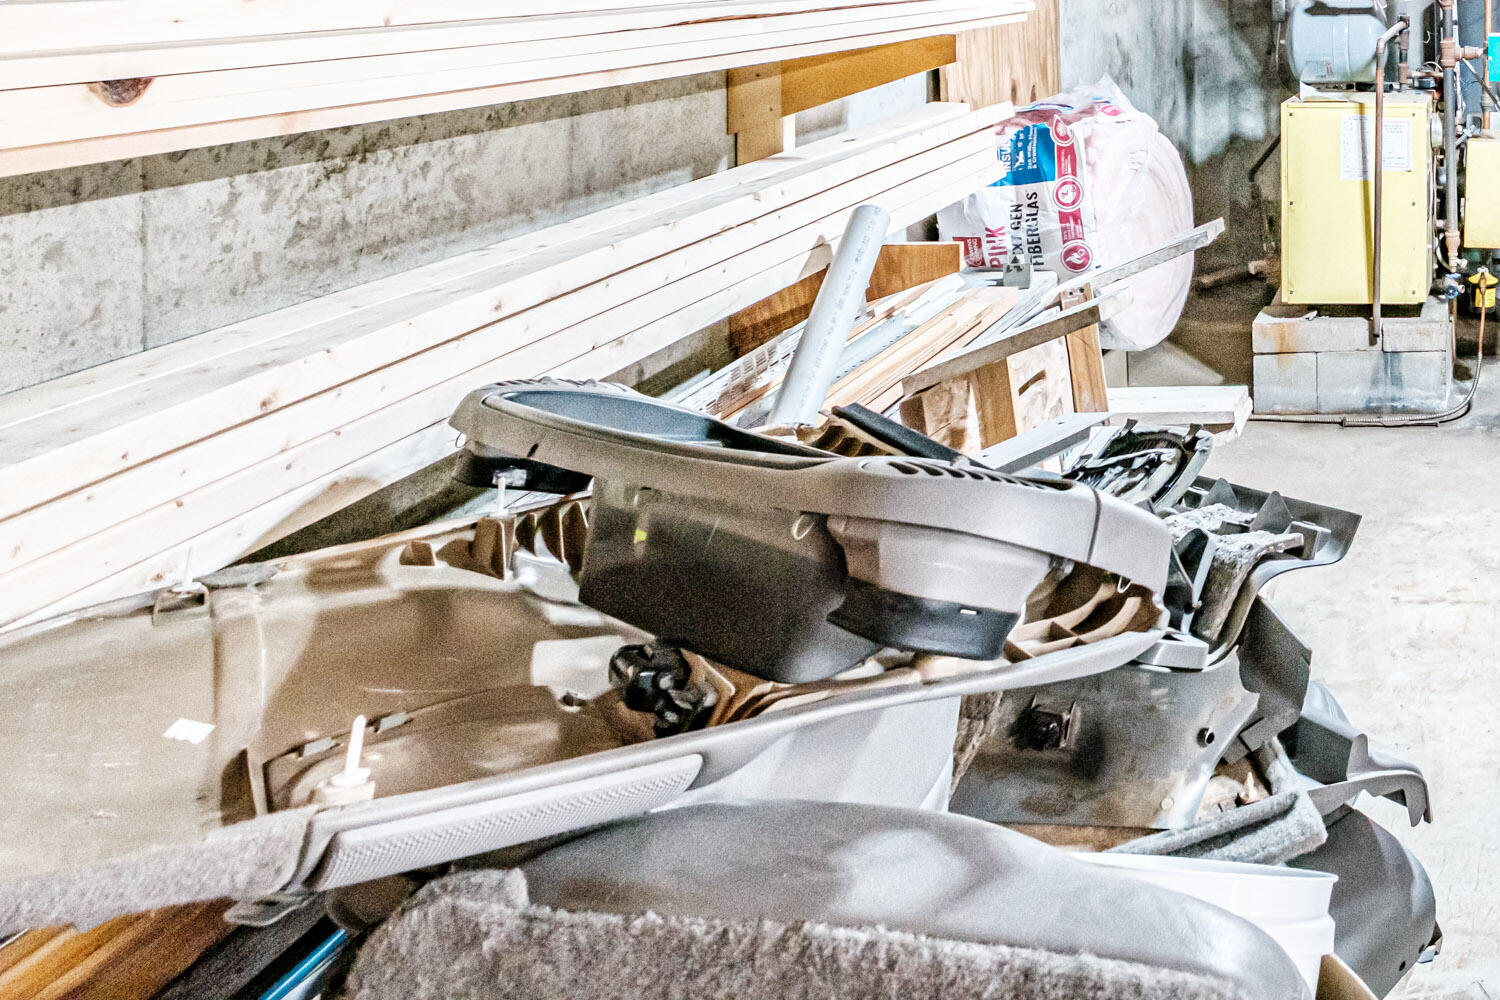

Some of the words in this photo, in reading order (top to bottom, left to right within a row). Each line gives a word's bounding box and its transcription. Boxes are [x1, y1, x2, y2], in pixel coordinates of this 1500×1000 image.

[1010, 203, 1023, 231] GEN
[1026, 191, 1044, 266] FIBERGLAS
[985, 225, 1008, 268] PINK
